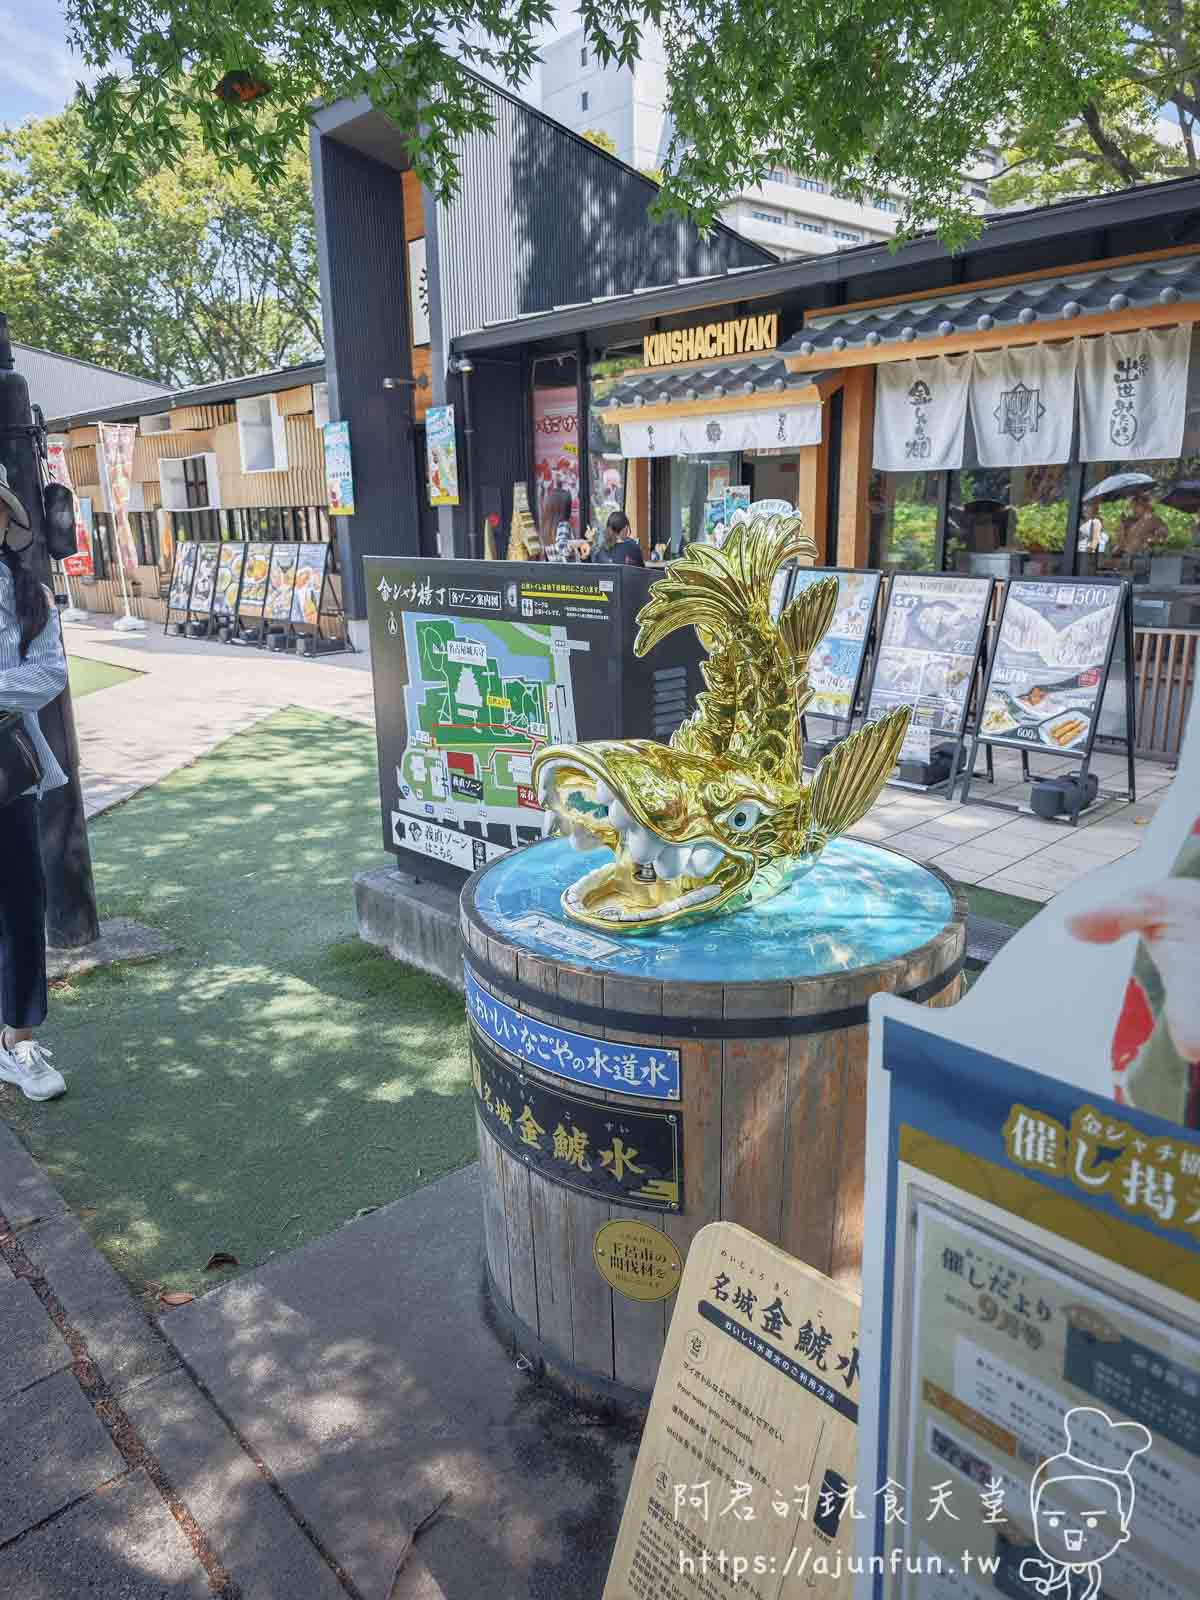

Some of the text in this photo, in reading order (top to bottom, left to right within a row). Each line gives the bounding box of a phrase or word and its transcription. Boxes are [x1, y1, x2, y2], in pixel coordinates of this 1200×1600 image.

[643, 313, 777, 367] KINSHACHIYAKI
[377, 575, 446, 608] 金シャチ横丁
[1012, 1112, 1200, 1224] 催し掲
